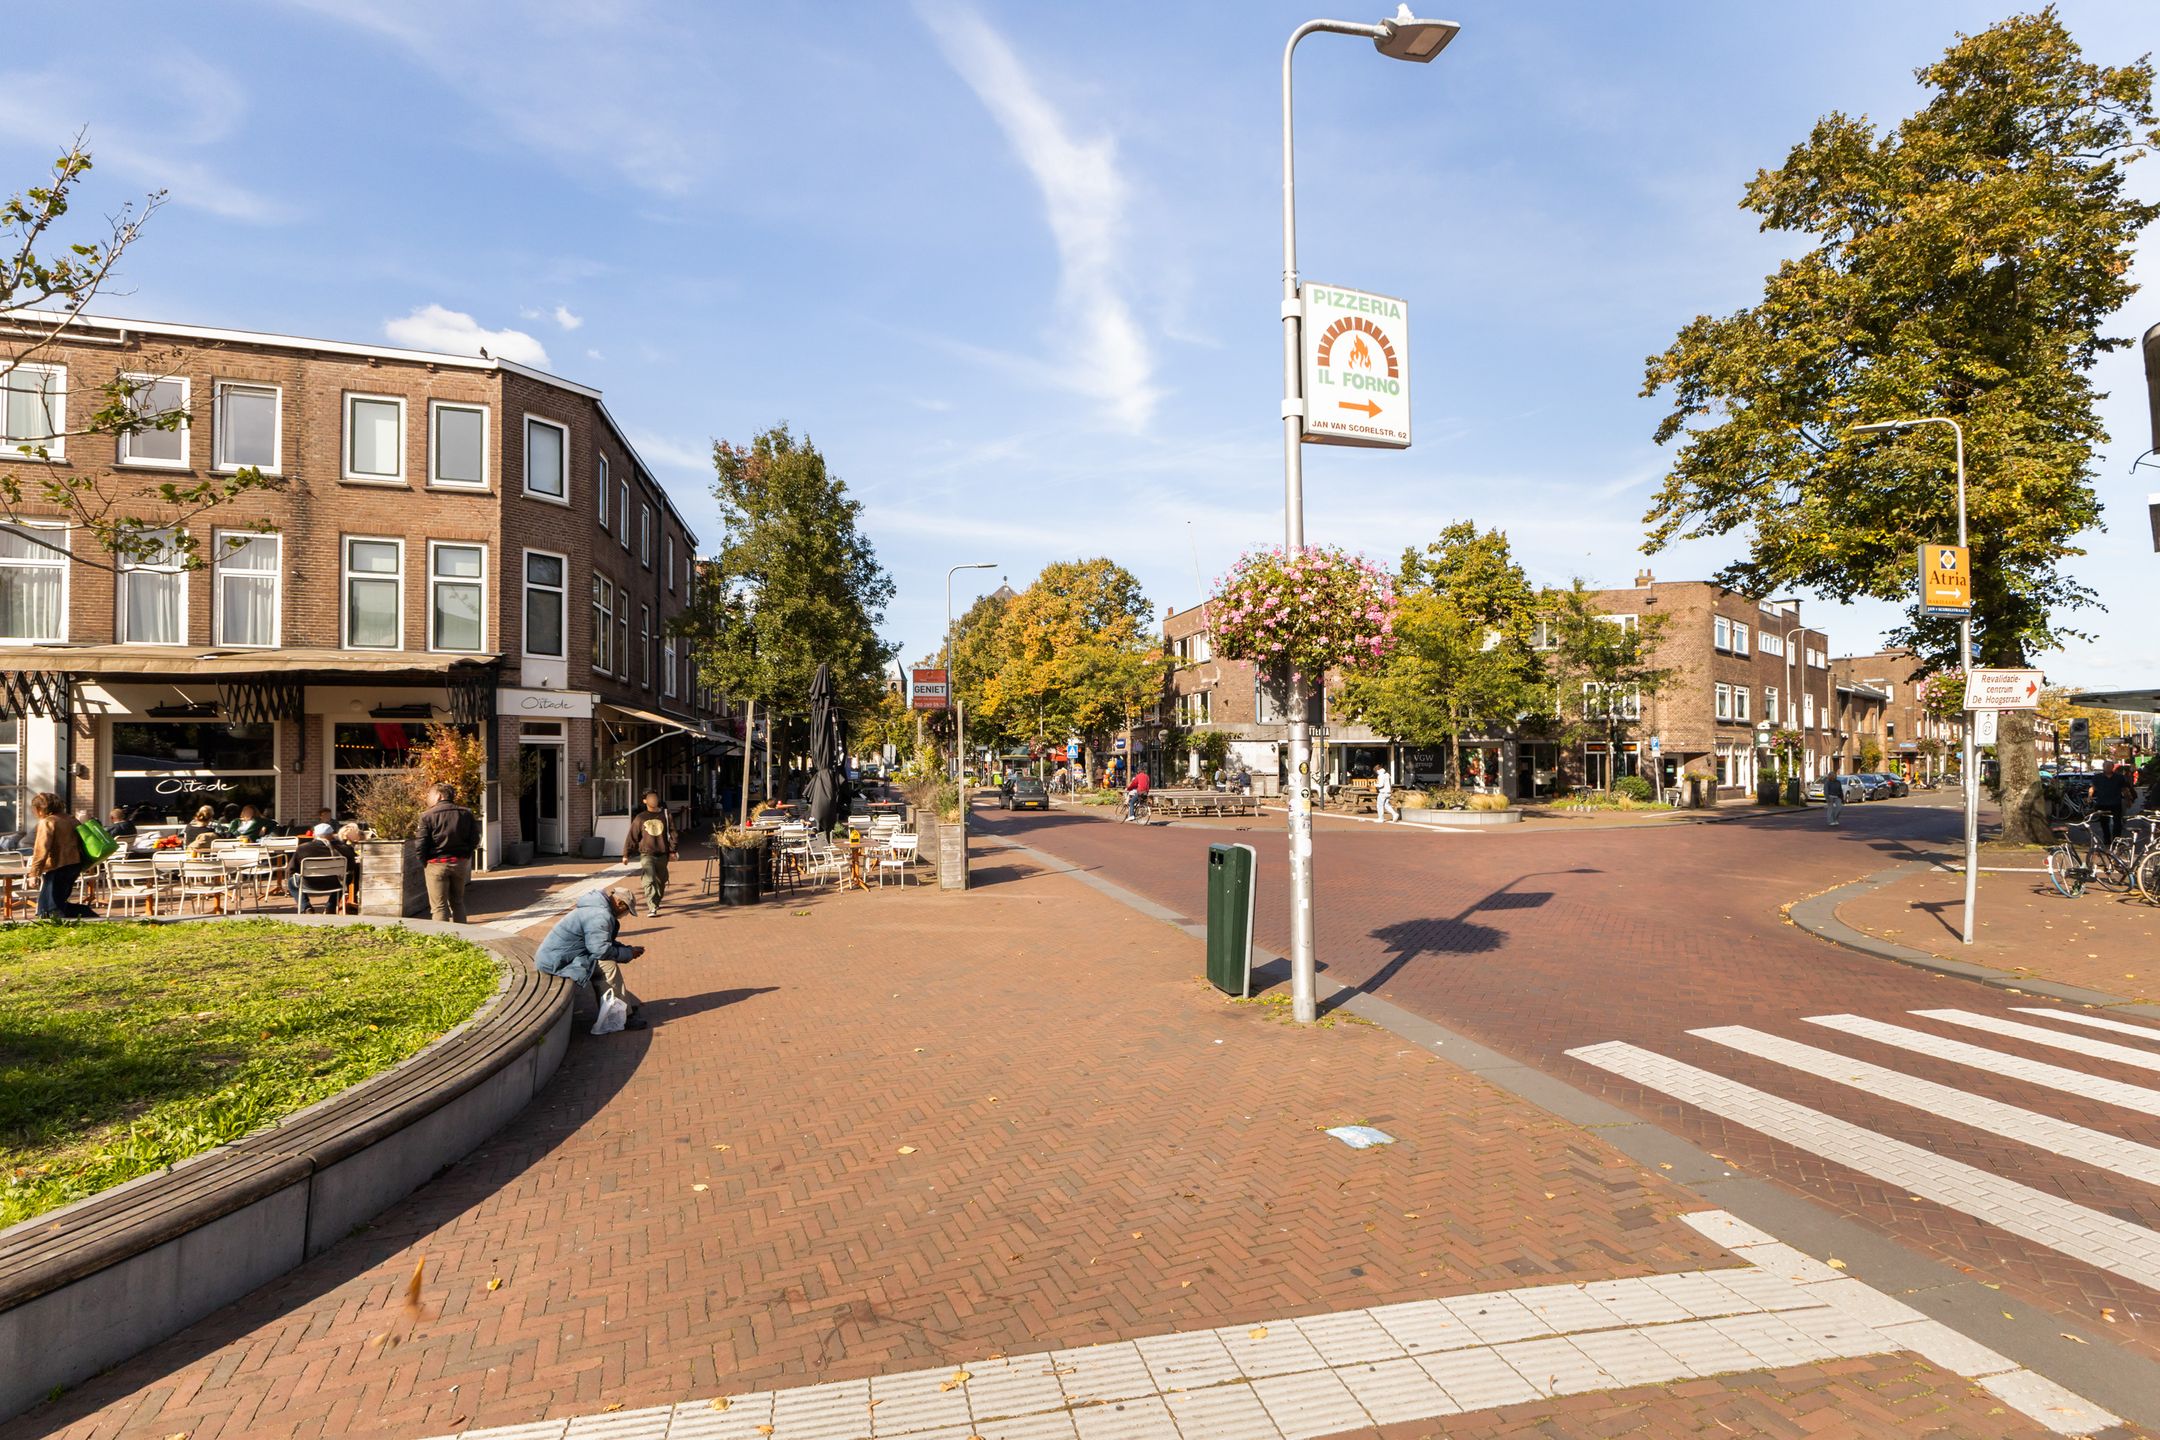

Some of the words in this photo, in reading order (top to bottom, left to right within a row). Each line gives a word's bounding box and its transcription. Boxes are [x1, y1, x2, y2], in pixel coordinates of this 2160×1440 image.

[1313, 288, 1401, 320] PIZZERIA
[1318, 368, 1335, 385] IL
[1343, 372, 1400, 396] FORNO
[1312, 420, 1329, 428] JAN
[1330, 422, 1347, 430] VAN
[1348, 424, 1396, 438] SCORELSTR.
[1929, 570, 1967, 586] Atria
[1981, 674, 2021, 683] Revalidatie-
[914, 685, 946, 694] GENIET
[520, 696, 576, 710] Ostade
[1972, 695, 1982, 704] De
[1985, 695, 2021, 705] Hoogstraat
[155, 778, 239, 794] Ostade
